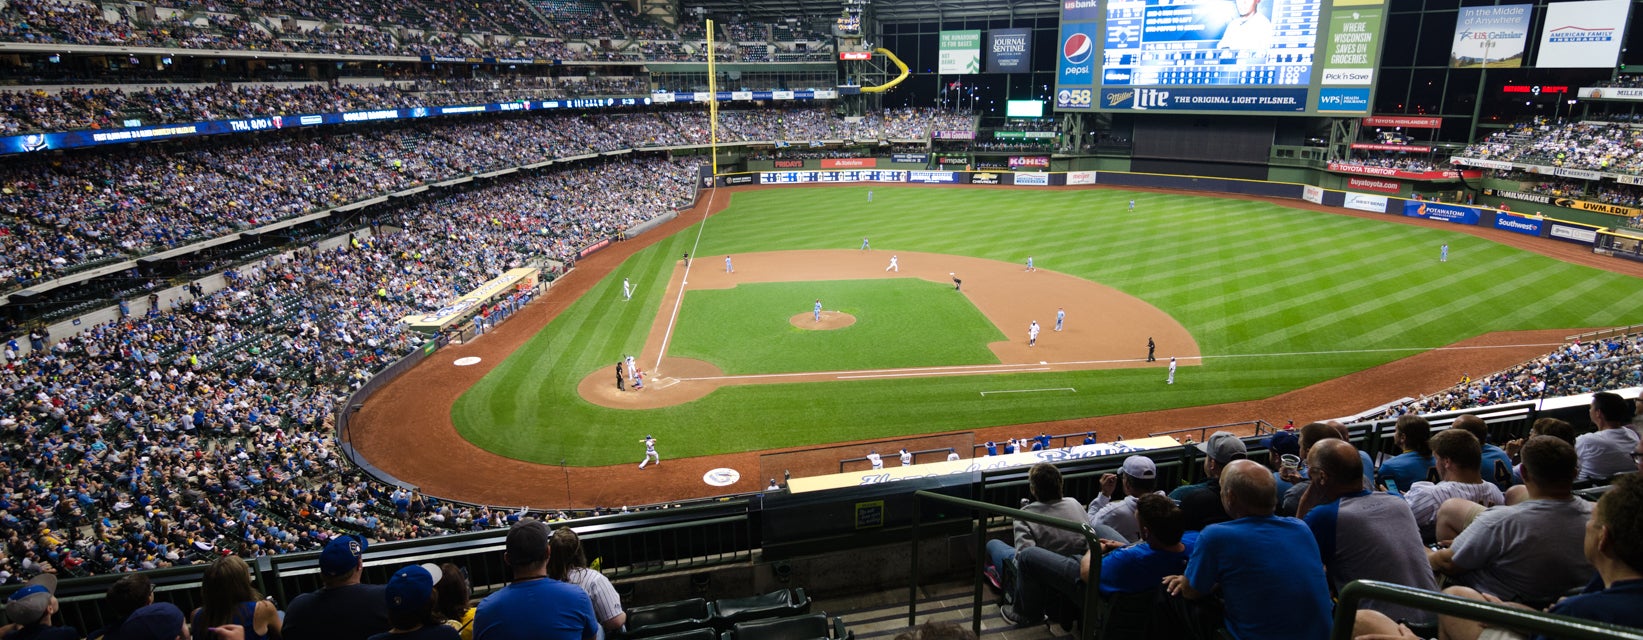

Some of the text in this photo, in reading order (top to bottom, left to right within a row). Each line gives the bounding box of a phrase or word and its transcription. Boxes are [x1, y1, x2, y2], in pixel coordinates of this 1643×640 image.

[1465, 9, 1474, 17] In
[1493, 7, 1525, 15] Middle
[1465, 16, 1521, 25] of Anywhere
[1343, 22, 1367, 32] WHERE
[1334, 33, 1372, 43] WISCONSIN
[1488, 31, 1523, 40] Cellular
[993, 38, 1026, 47] JOURNAL
[992, 45, 1026, 53] SENTINEL
[1335, 44, 1367, 54] SAVES ON
[1331, 54, 1368, 64] GROCERIES.
[1065, 66, 1089, 76] pepsi
[1070, 89, 1091, 105] 58
[1106, 88, 1169, 110] Miller Lite
[1191, 96, 1230, 104] ORIGINAL
[1231, 96, 1258, 104] LIGHT
[1258, 97, 1297, 105] PILSNER.
[1321, 95, 1341, 104] WPS
[230, 121, 250, 131] THU,
[250, 119, 267, 130] 8/10
[944, 157, 967, 165] impact
[1340, 165, 1397, 176] TOYOTA TERRITORY
[1350, 178, 1398, 190] buyatoyota.com
[1426, 207, 1465, 216] POTAWATOMI
[1583, 202, 1629, 215] UWM.EDU
[1498, 218, 1532, 230] Southwest
